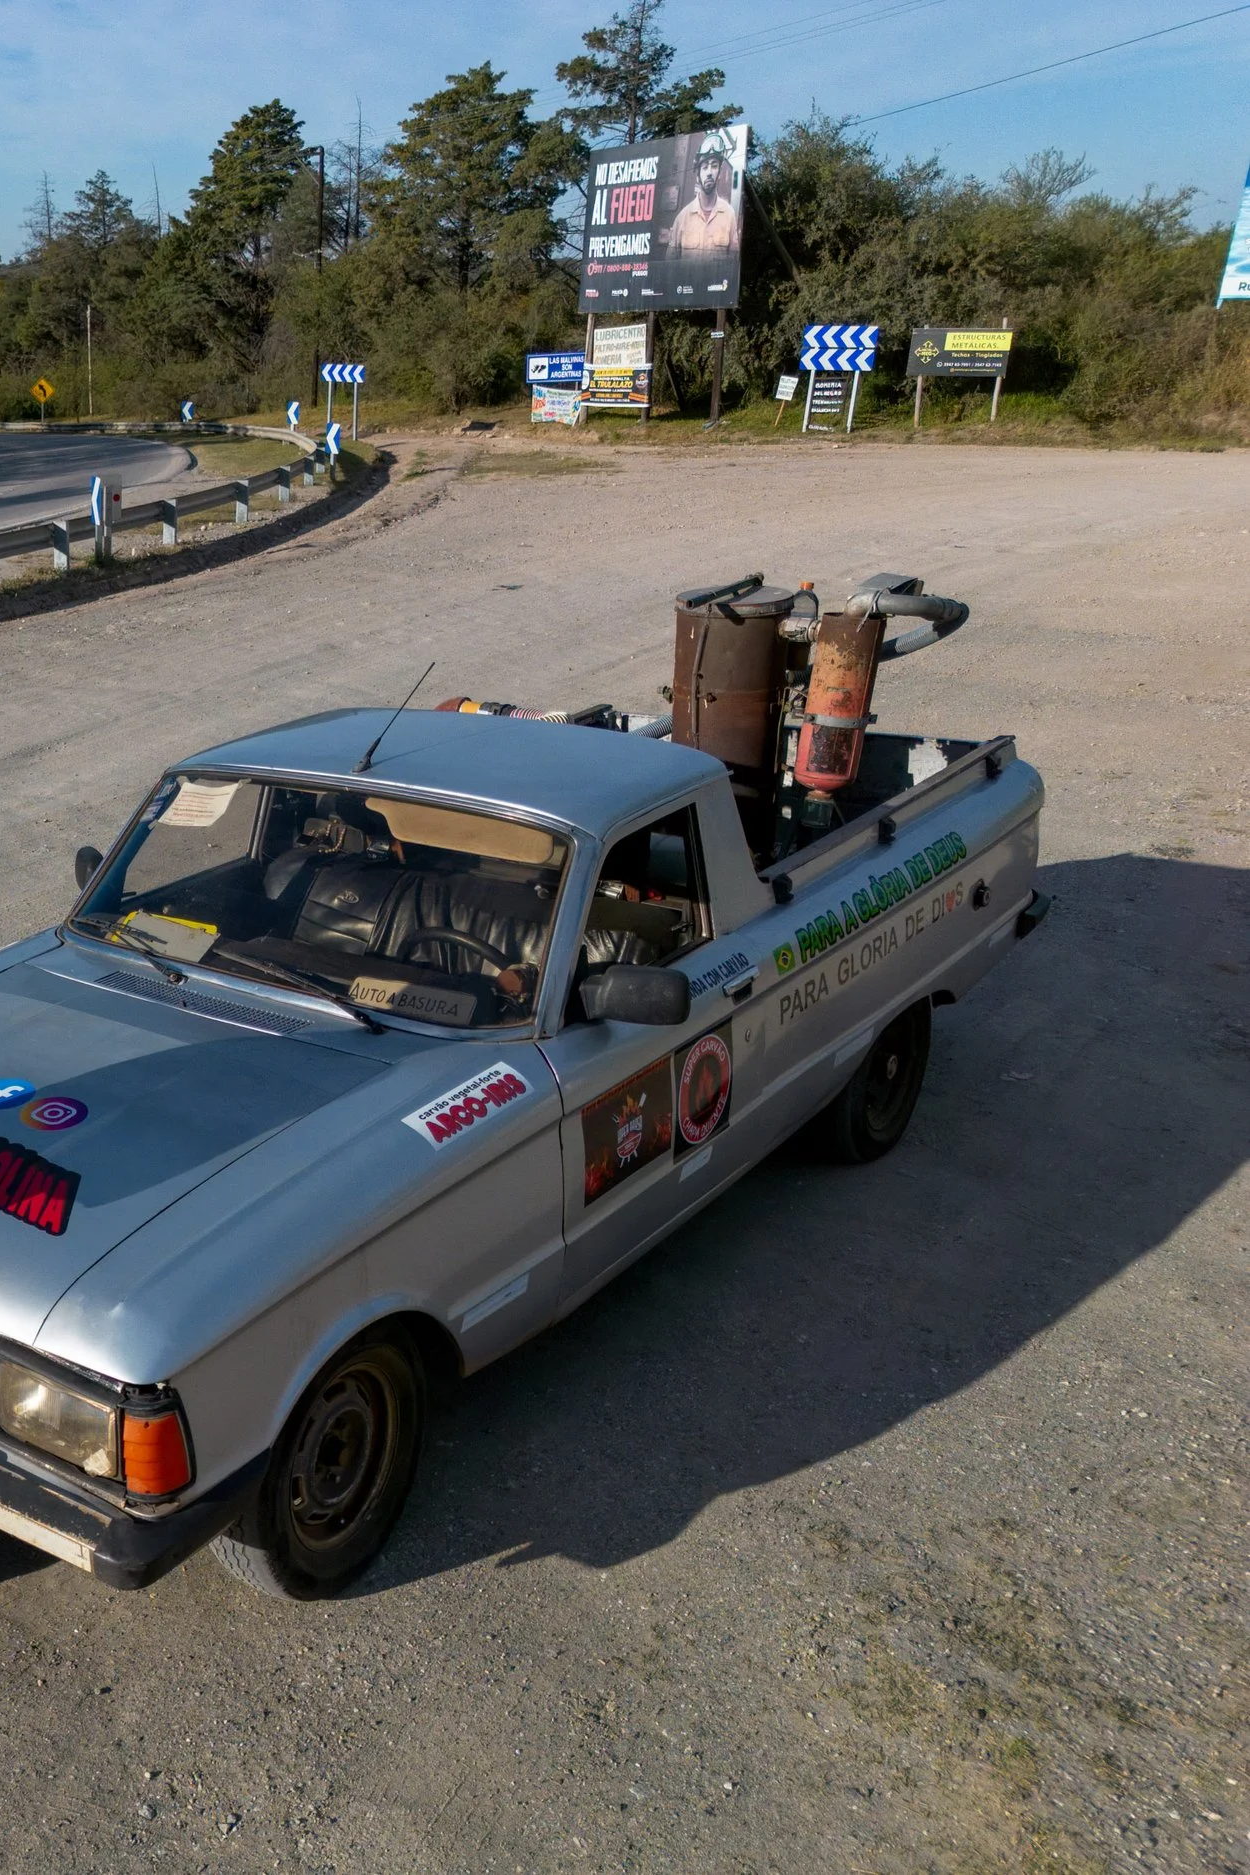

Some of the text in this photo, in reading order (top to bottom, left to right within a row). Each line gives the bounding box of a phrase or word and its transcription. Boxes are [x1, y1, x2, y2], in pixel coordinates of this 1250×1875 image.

[595, 156, 659, 186] NO DESAFIEMOS
[591, 184, 655, 225] AL FUEGO
[589, 233, 651, 258] PREVENGAMOS
[595, 326, 646, 341] LUBRICENTRO
[561, 356, 584, 364] MALVINAS
[795, 831, 967, 964] PARA A GLÓRIA DE DEUS
[702, 968, 724, 988] COM
[779, 972, 829, 1025] PARA
[837, 926, 899, 986] GLORIA
[905, 907, 924, 942] DE
[350, 982, 459, 1017] AUTO A BASURA
[684, 1047, 701, 1085] SUPER
[418, 1100, 449, 1120] carvão
